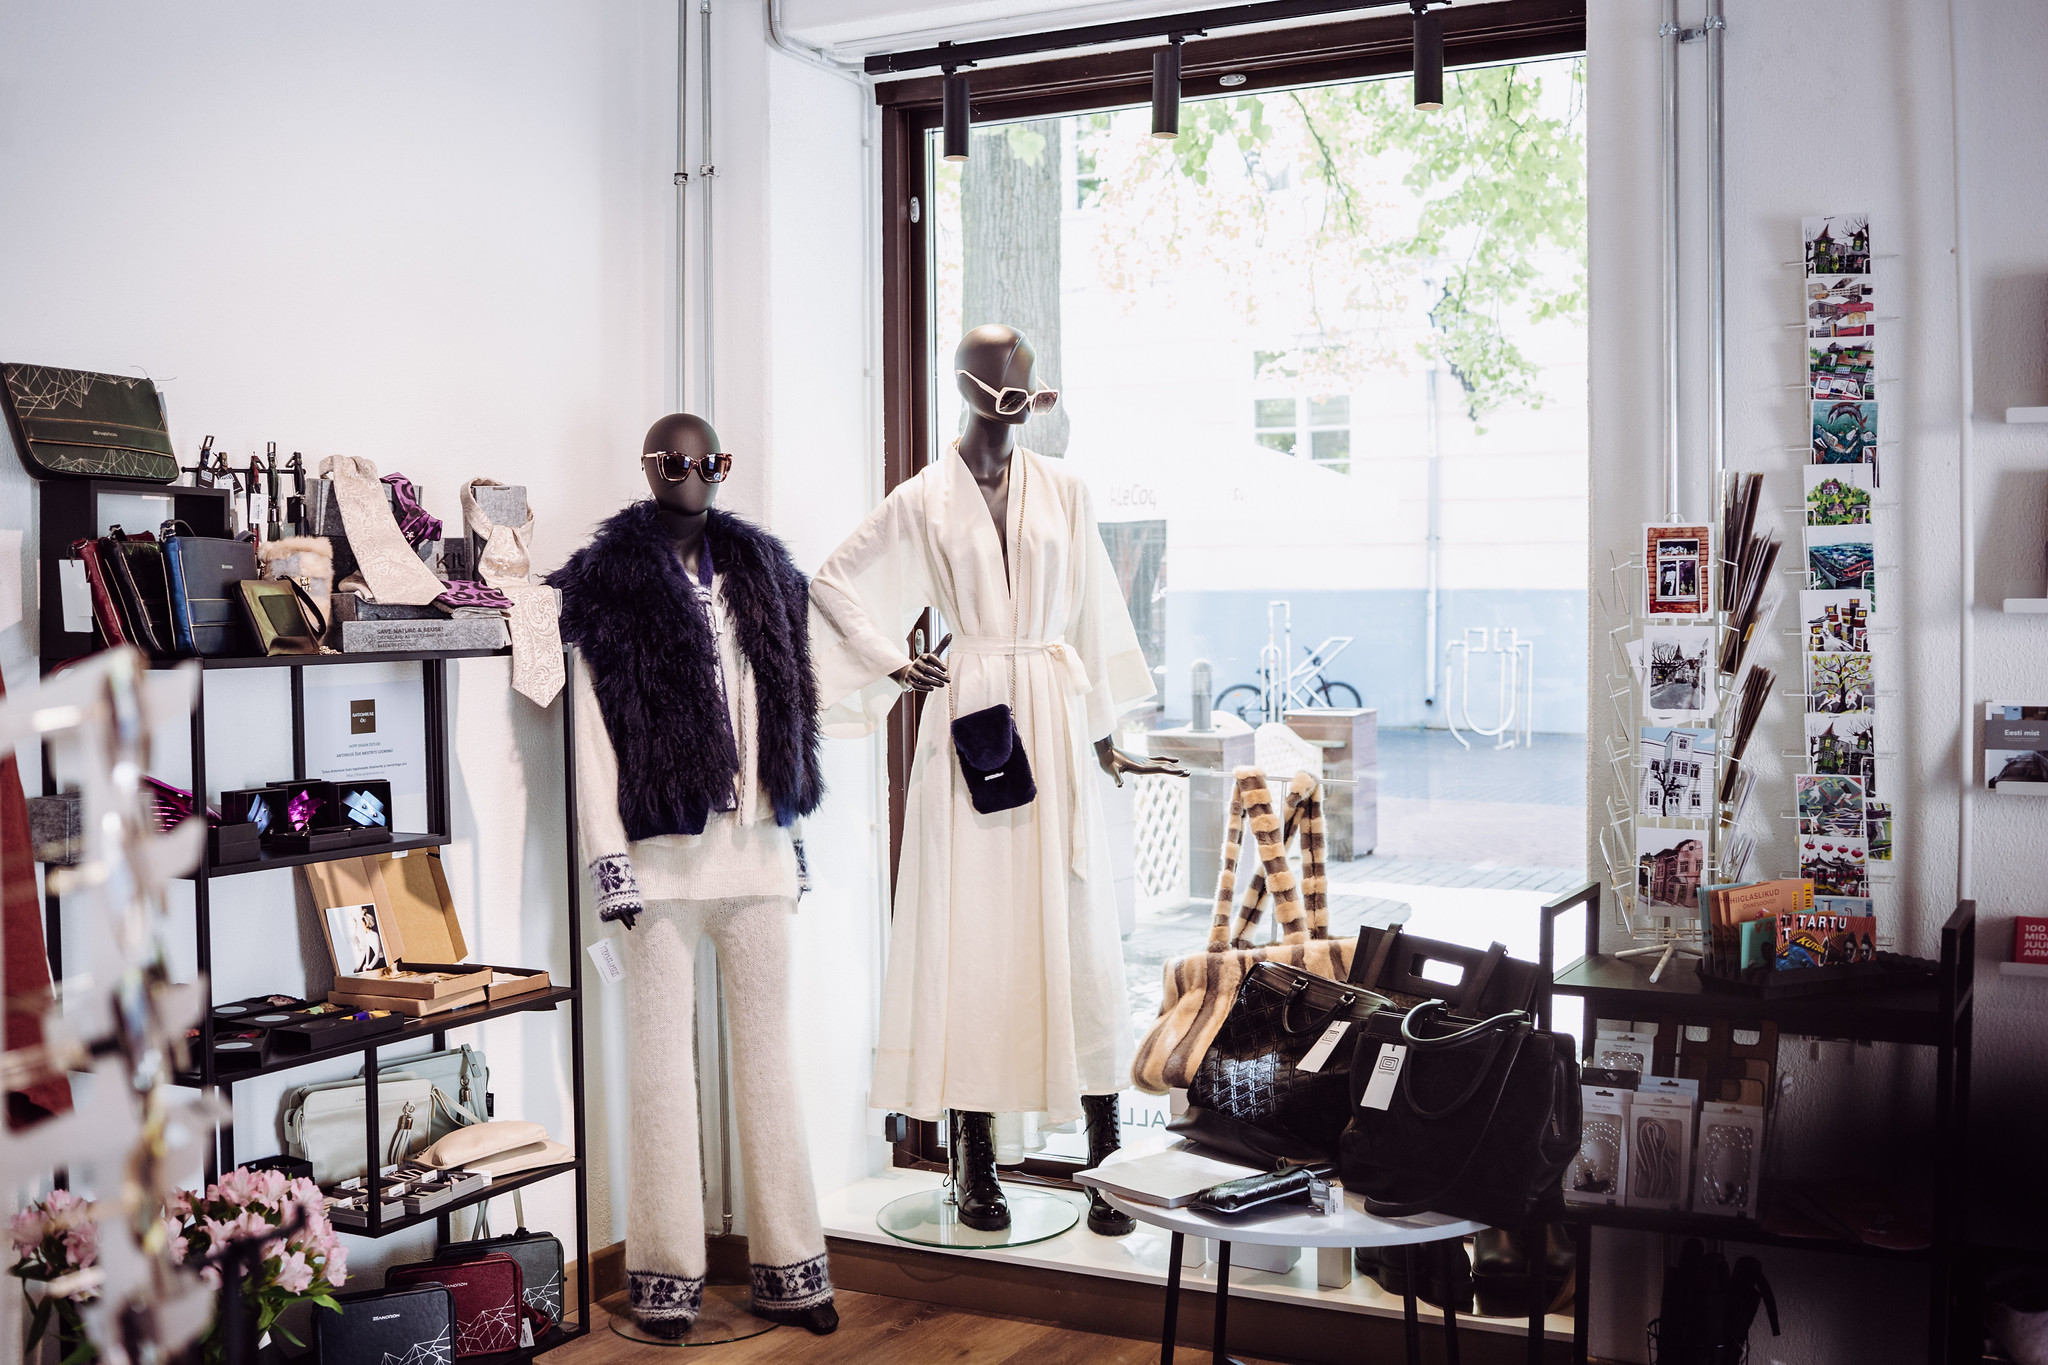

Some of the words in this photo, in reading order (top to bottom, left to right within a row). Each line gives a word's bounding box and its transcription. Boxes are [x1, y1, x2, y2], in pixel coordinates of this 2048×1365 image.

[1730, 889, 1780, 904] HIIGLASLIKUD
[1799, 915, 1847, 928] TARTU
[2025, 924, 2046, 932] 100
[2024, 933, 2048, 941] MID
